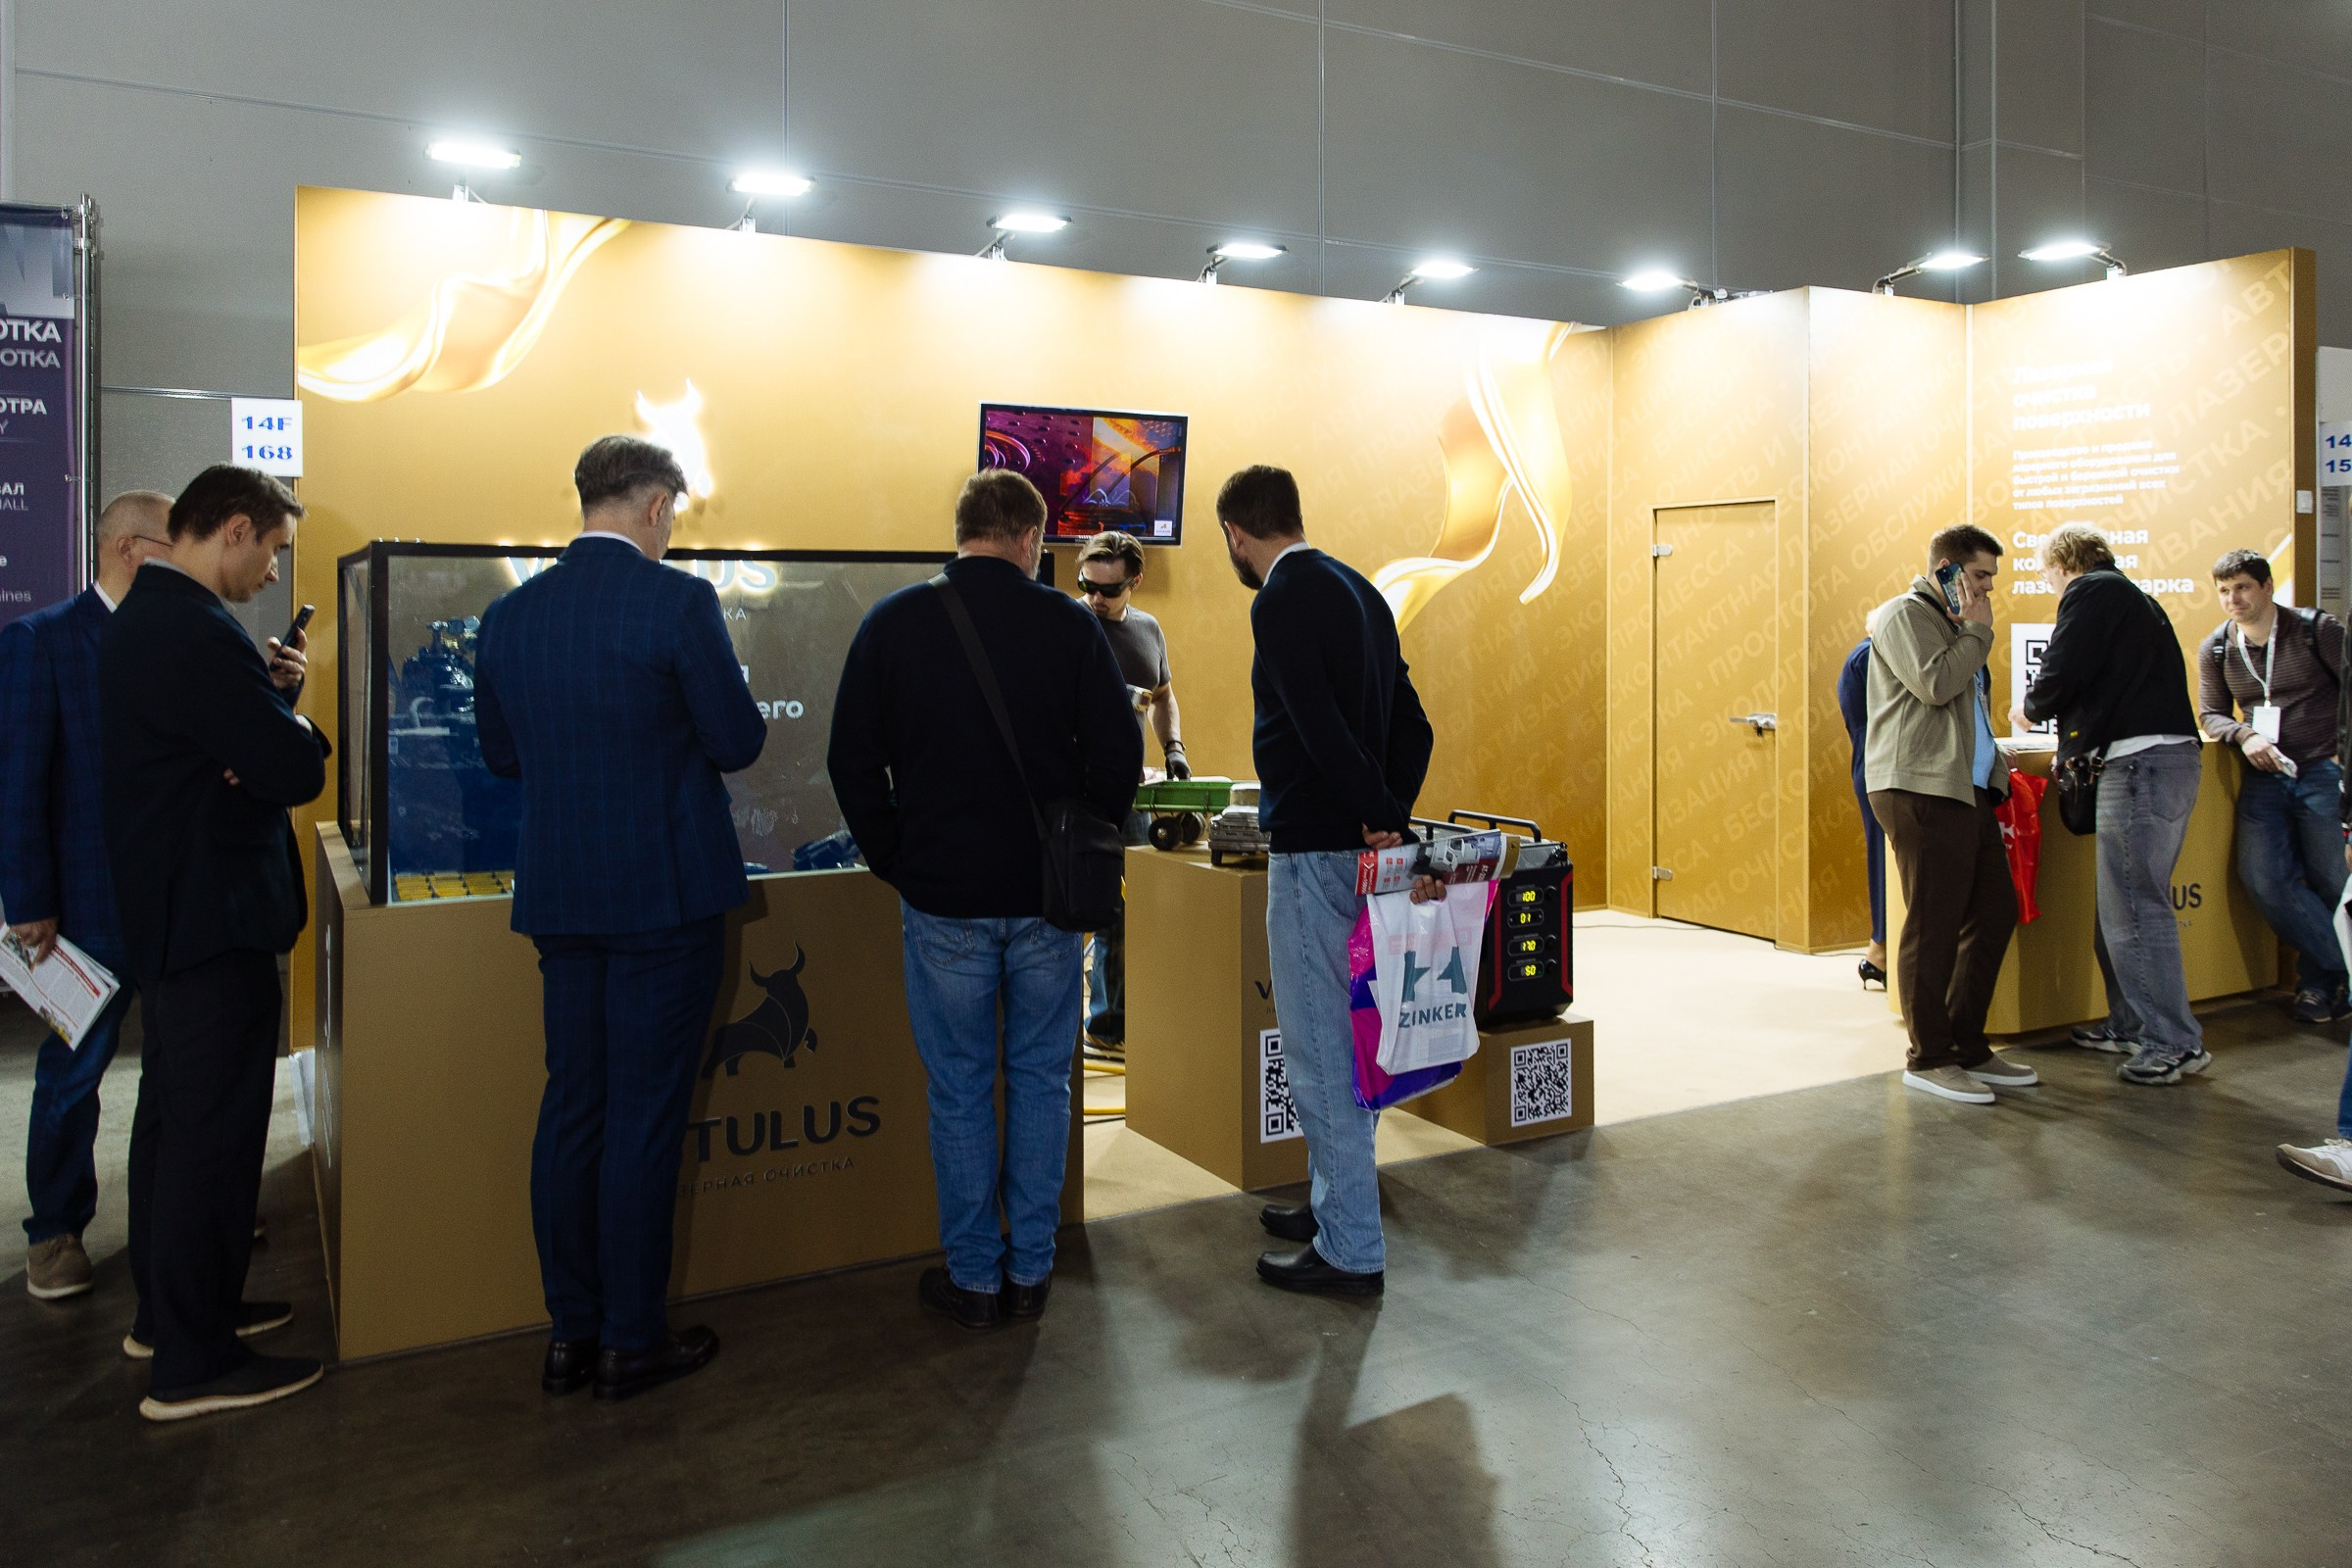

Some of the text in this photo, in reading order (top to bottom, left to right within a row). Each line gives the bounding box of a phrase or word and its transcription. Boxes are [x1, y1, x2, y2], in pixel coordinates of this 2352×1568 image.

[241, 416, 293, 431] 14F
[2012, 402, 2152, 430] поверхности
[241, 444, 293, 461] 168
[2138, 479, 2167, 490] всех
[2012, 501, 2045, 511] типов
[1397, 1002, 1468, 1029] ZINKER
